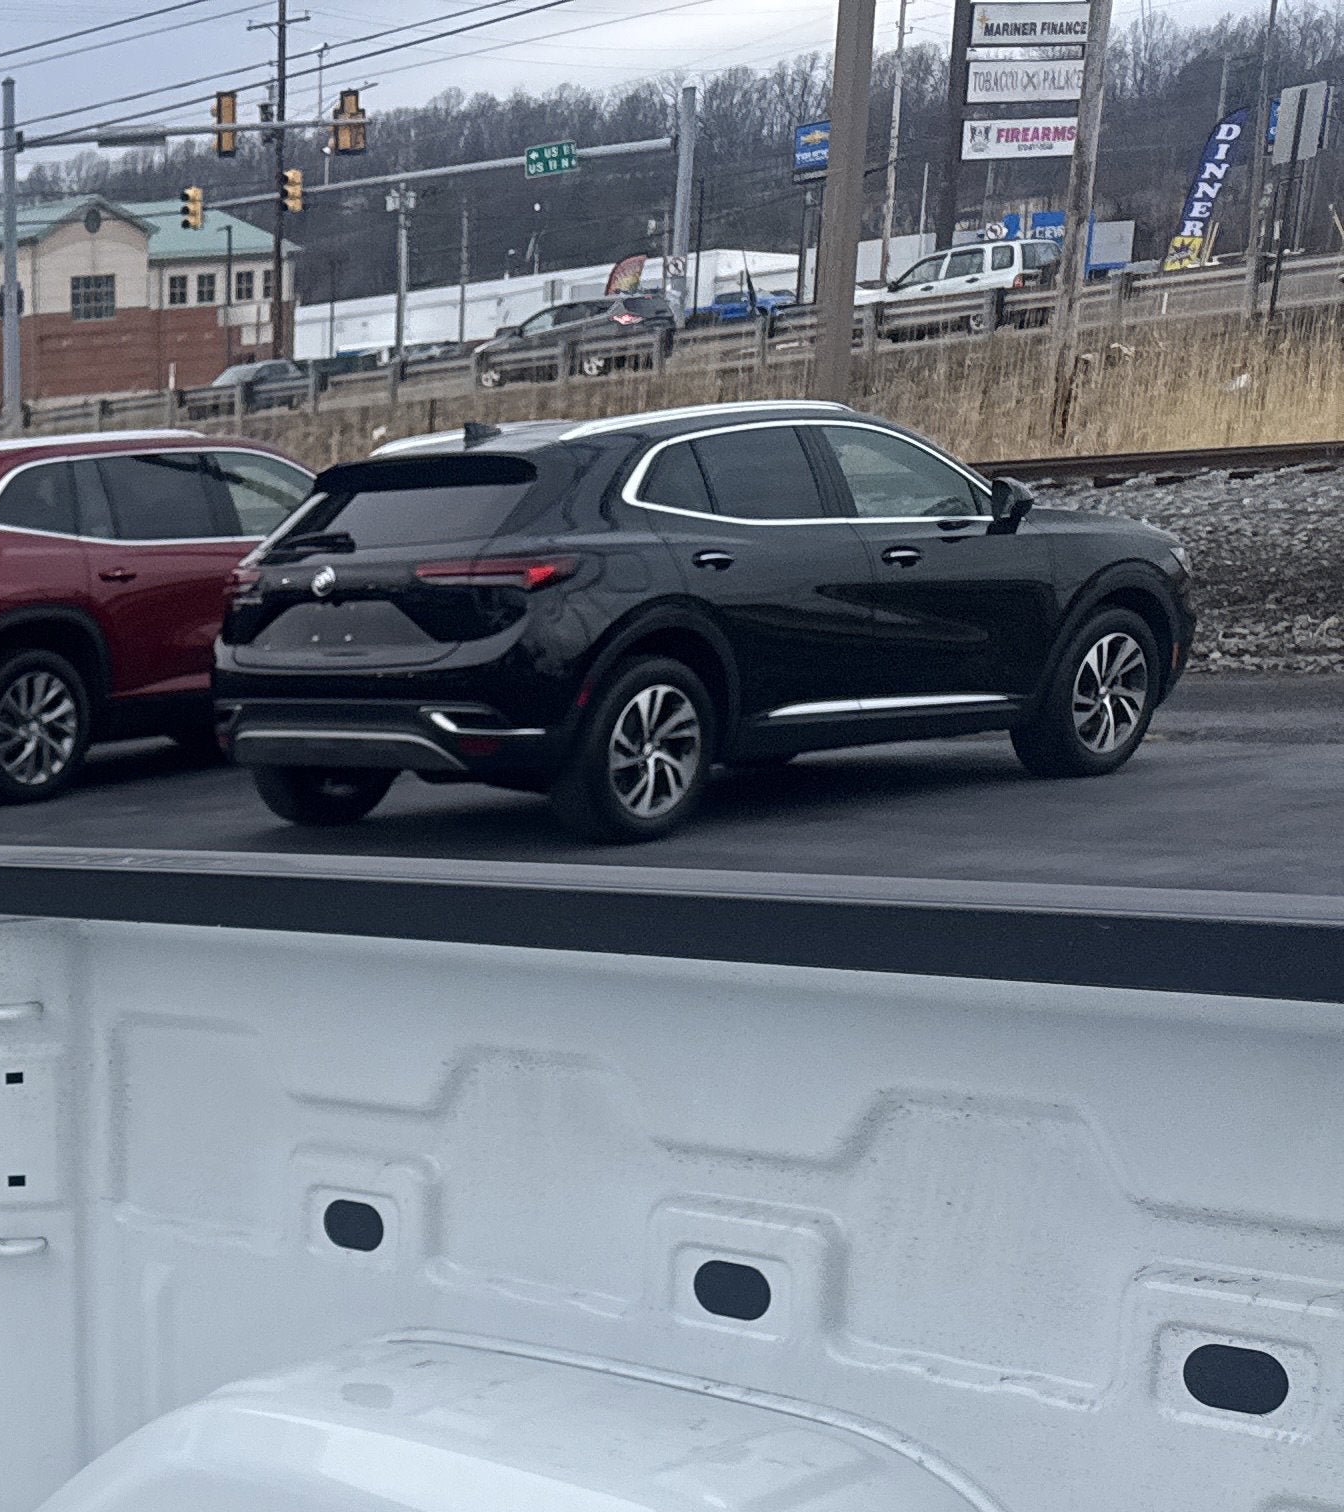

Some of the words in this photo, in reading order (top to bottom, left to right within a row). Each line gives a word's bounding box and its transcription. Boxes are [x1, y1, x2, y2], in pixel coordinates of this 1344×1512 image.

[984, 22, 1037, 37] MARINER
[1040, 21, 1088, 35] FINANCE
[996, 126, 1077, 143] FIREARMS
[1181, 123, 1241, 236] DINNER
